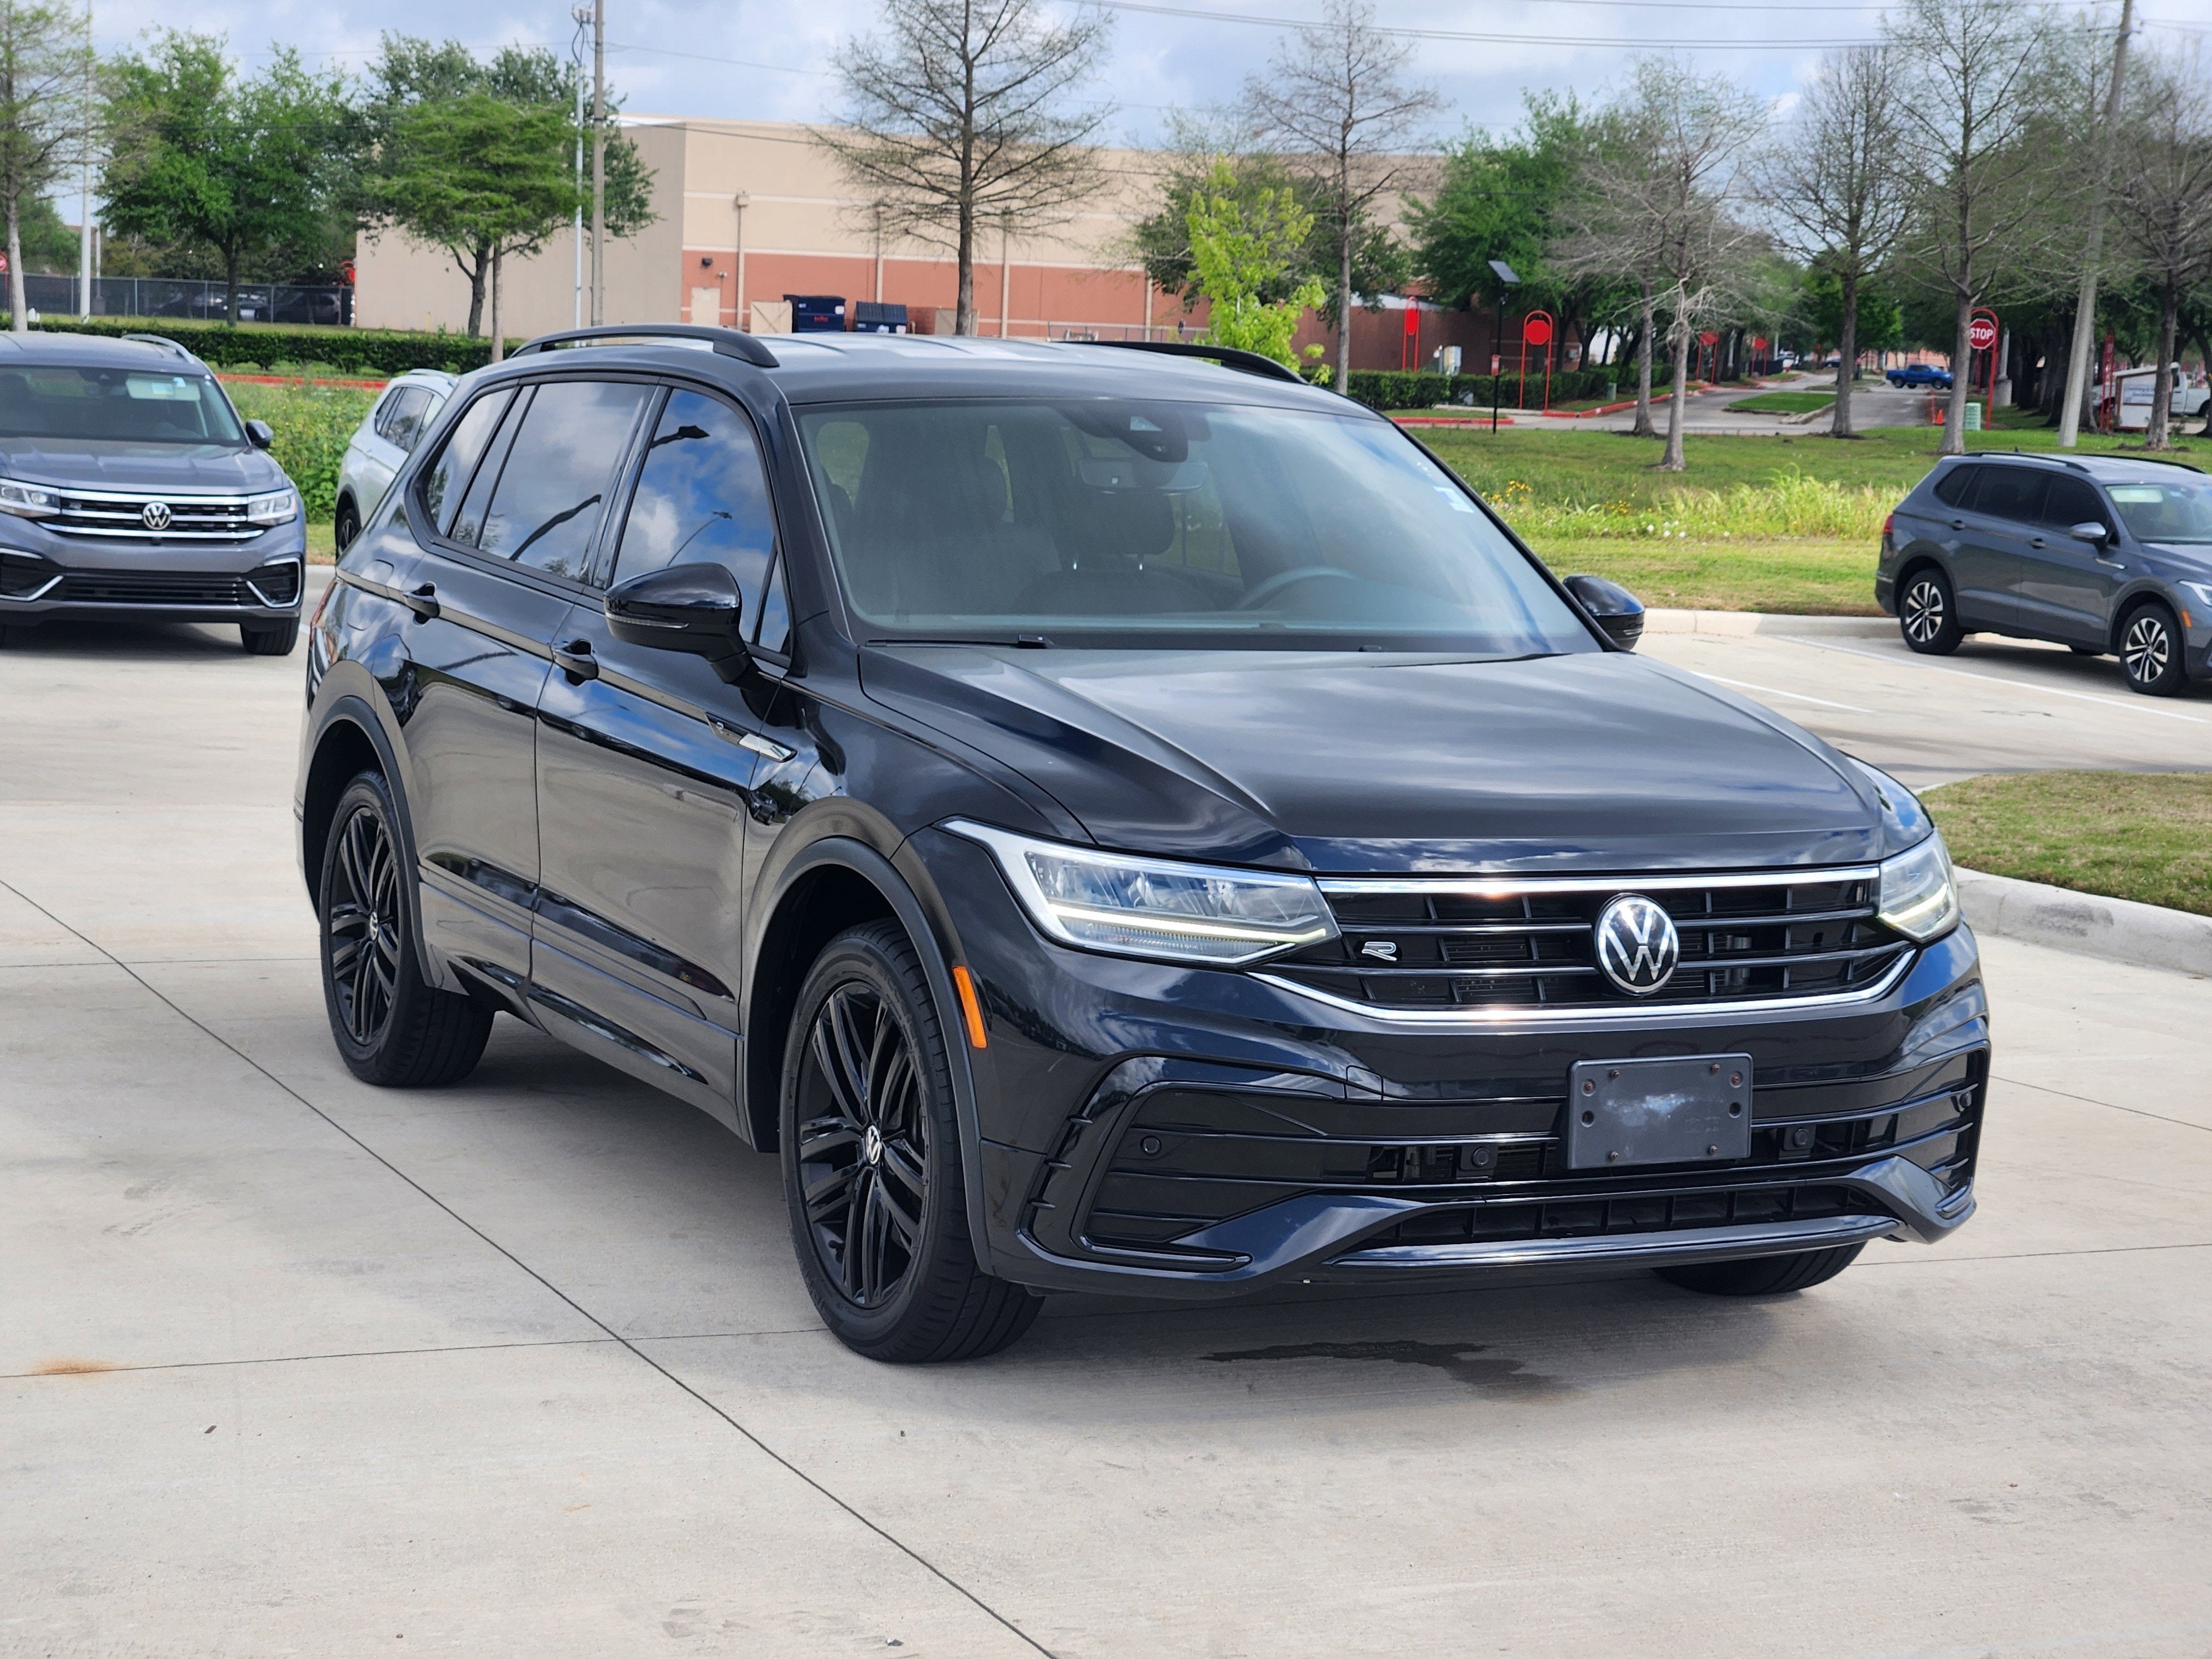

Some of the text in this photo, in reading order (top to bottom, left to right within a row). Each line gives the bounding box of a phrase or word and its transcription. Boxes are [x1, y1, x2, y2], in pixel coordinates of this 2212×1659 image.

[1970, 327, 1994, 340] STOP
[144, 502, 170, 529] VW
[1361, 941, 1397, 961] R
[1600, 899, 1677, 988] VW
